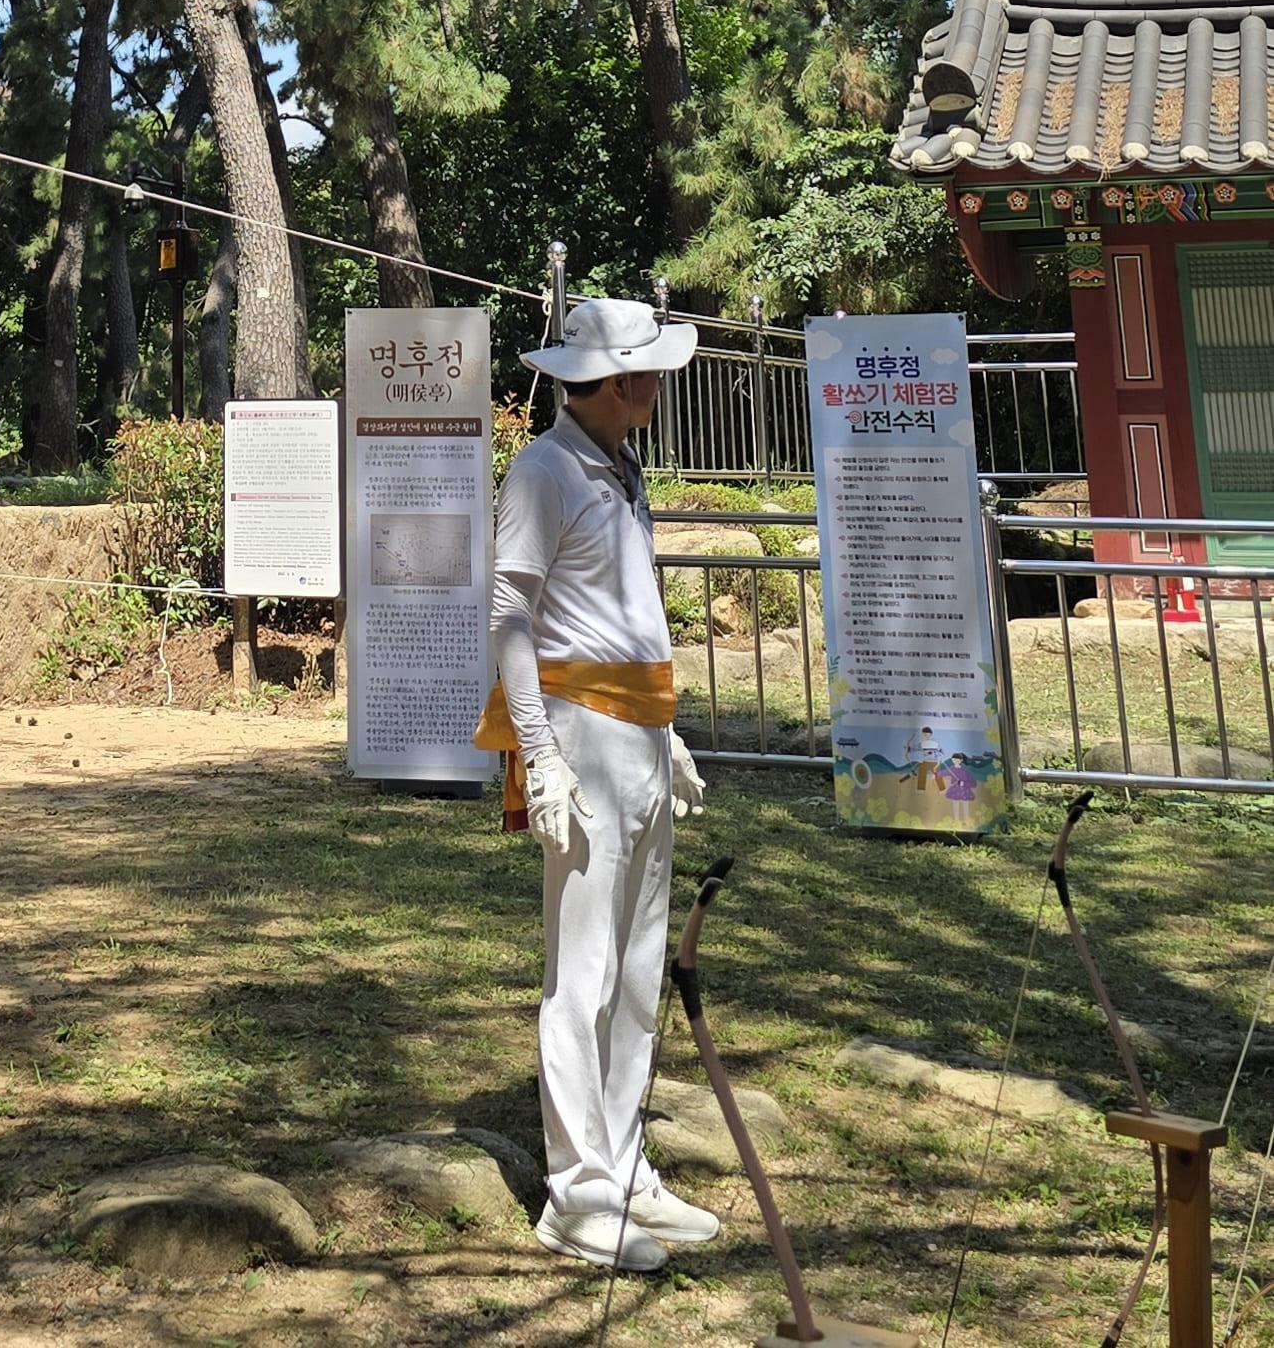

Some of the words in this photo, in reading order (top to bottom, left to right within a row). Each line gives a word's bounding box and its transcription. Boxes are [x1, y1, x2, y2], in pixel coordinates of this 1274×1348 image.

[369, 340, 463, 379] 명후정
[855, 355, 921, 379] 명후정
[822, 383, 888, 406] 활쏘기
[892, 382, 958, 405] 체험장
[847, 409, 936, 433] 안전수칙
